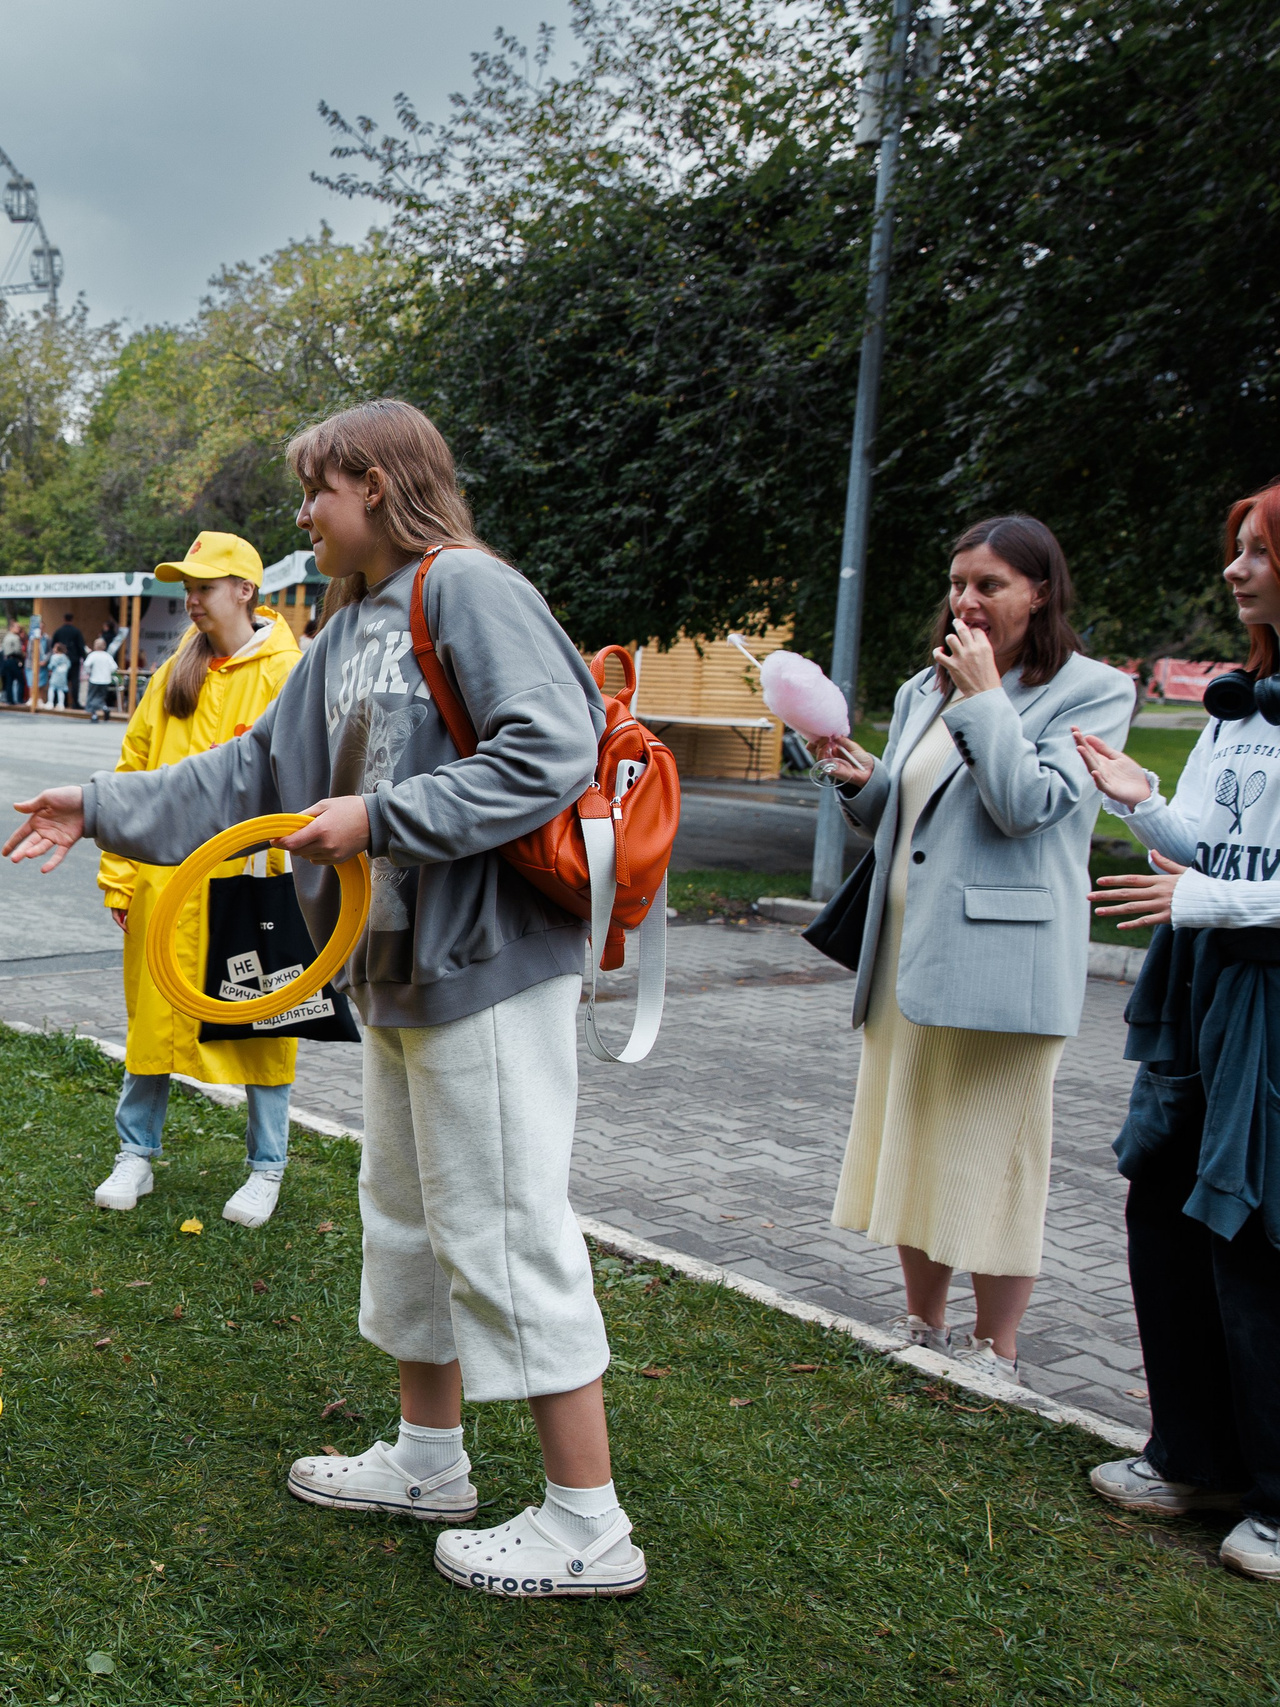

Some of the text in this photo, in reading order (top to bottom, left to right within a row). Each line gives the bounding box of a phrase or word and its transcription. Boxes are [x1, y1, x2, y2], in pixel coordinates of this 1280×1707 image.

[42, 580, 116, 592] ЭКСПЕРИМЕНТЫ
[233, 958, 255, 976] НЕ
[262, 969, 301, 989] НУЖНО
[222, 984, 262, 1000] КРИЧА
[470, 1572, 554, 1593] crocs
